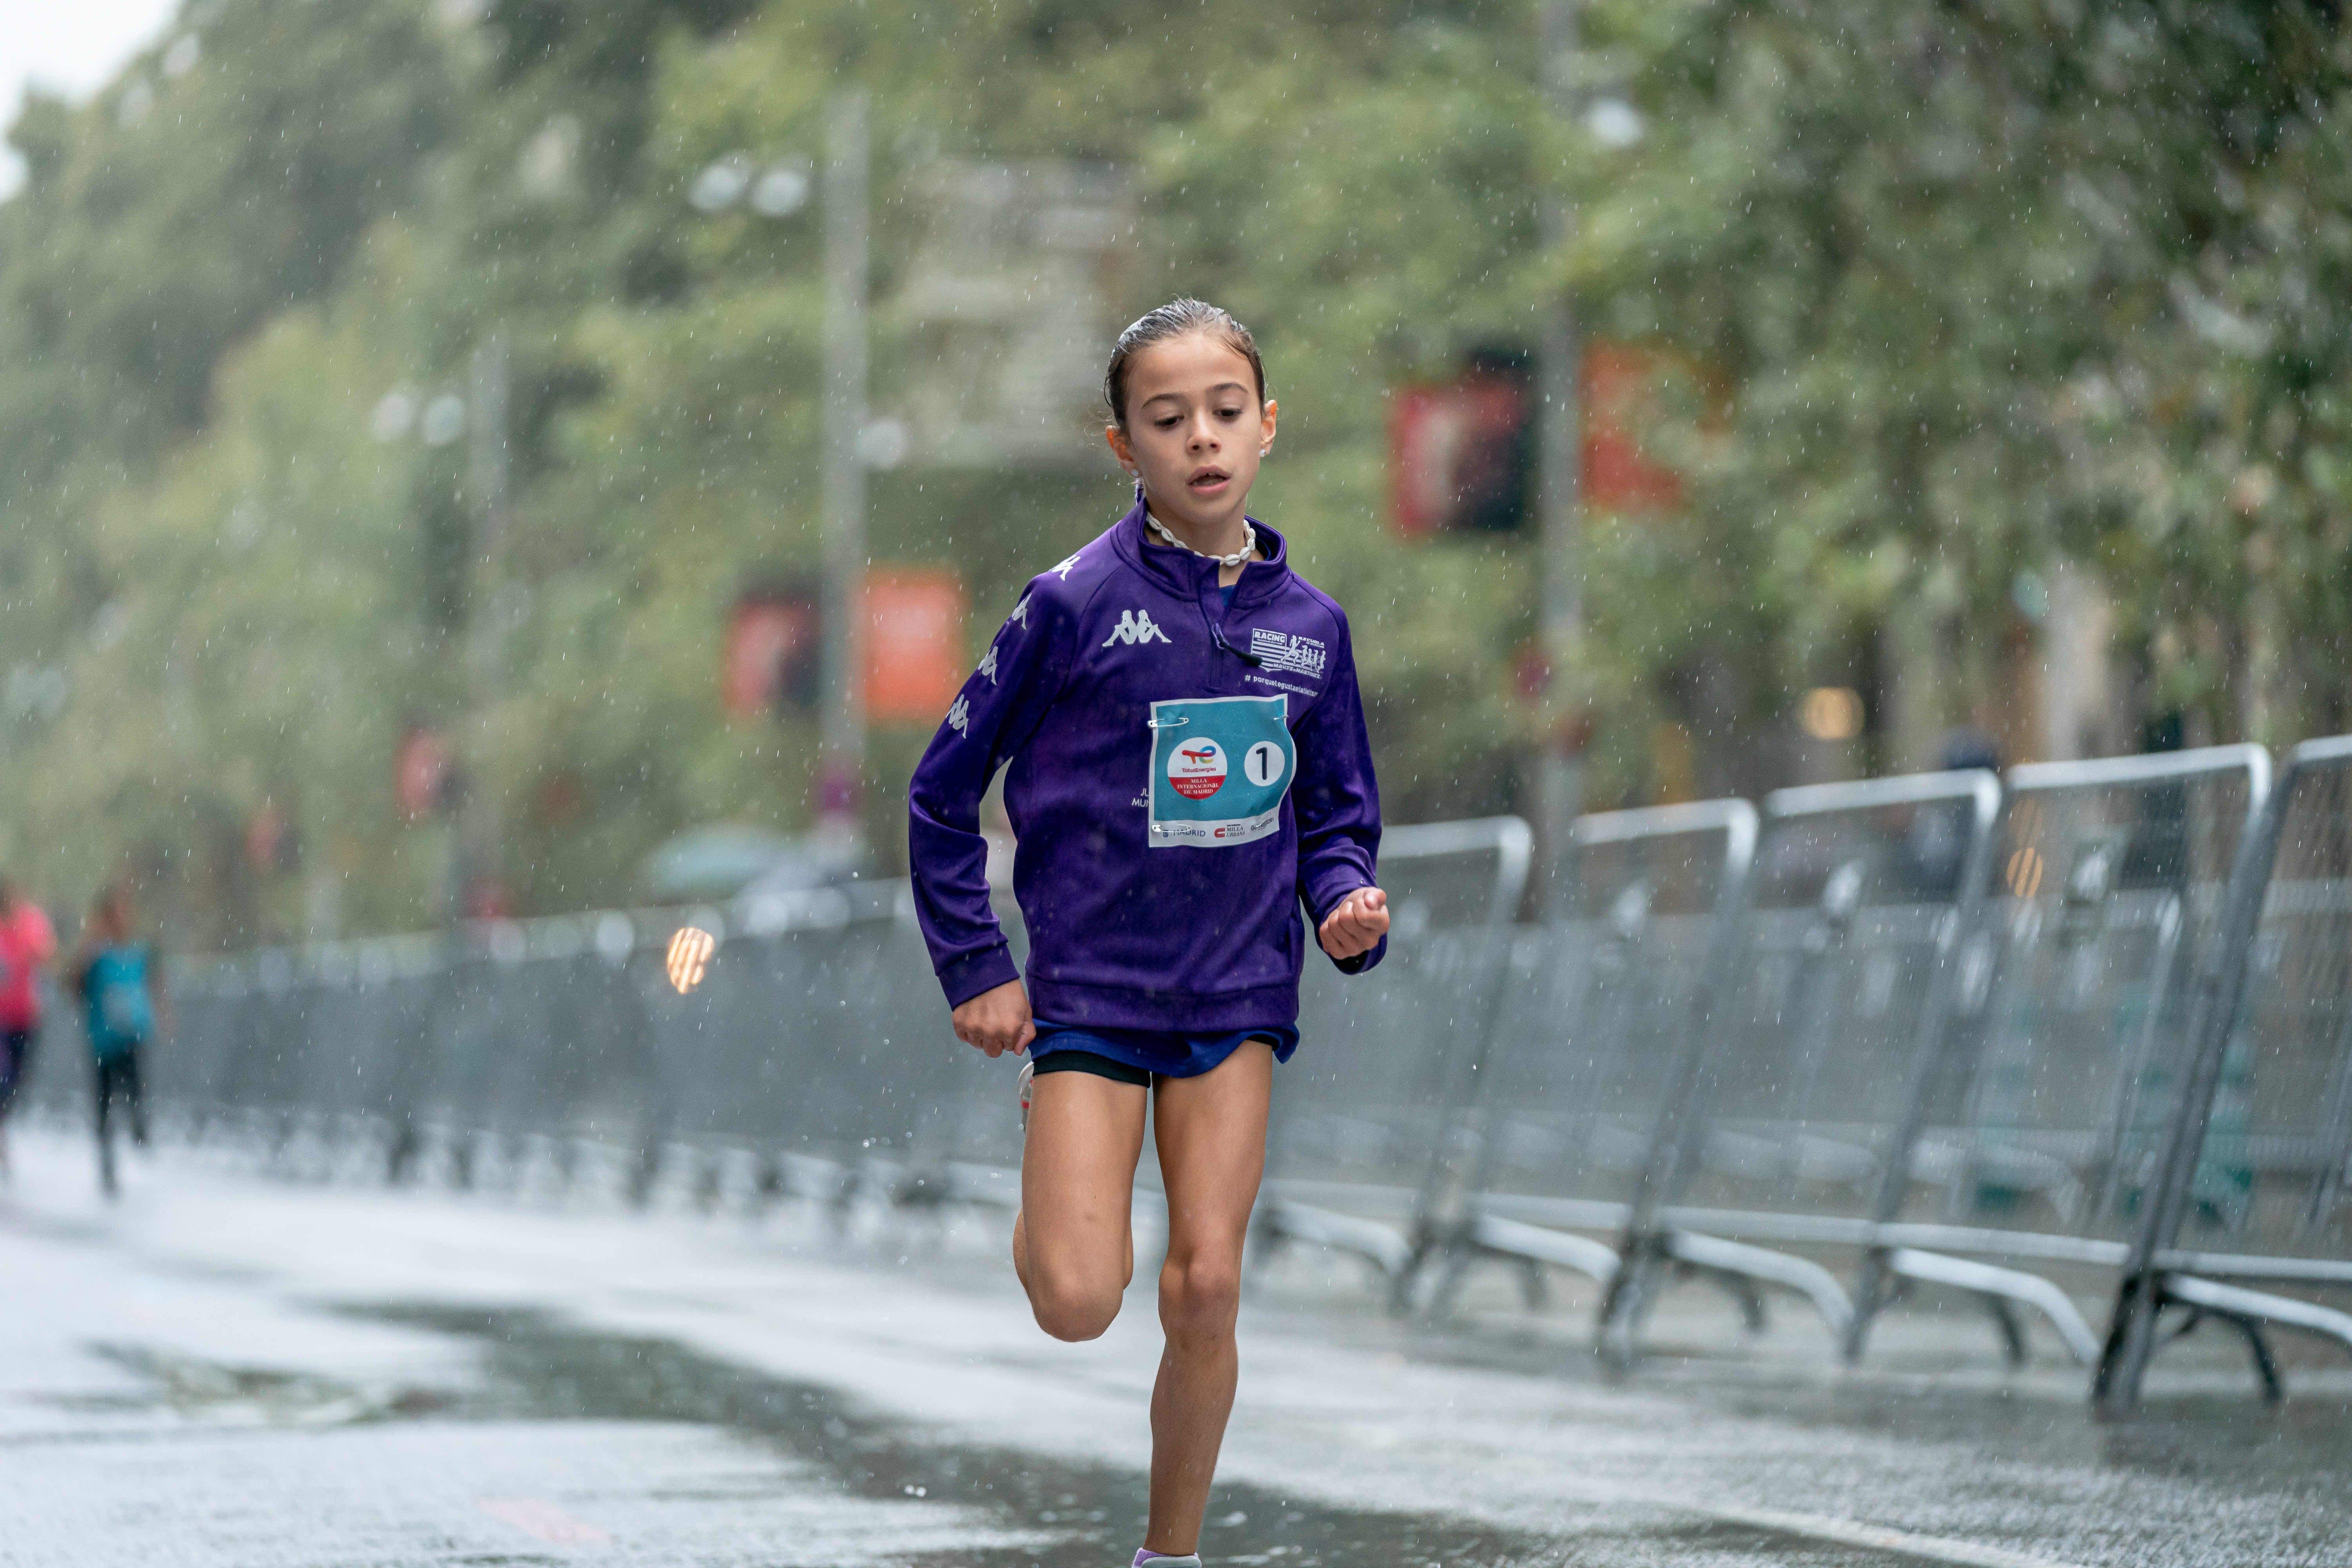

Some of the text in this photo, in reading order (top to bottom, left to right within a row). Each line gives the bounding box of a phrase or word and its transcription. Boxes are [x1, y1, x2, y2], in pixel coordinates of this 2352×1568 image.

[1254, 632, 1285, 643] RACING
[1298, 637, 1324, 646] ESCUELA
[1256, 747, 1267, 780] 1
